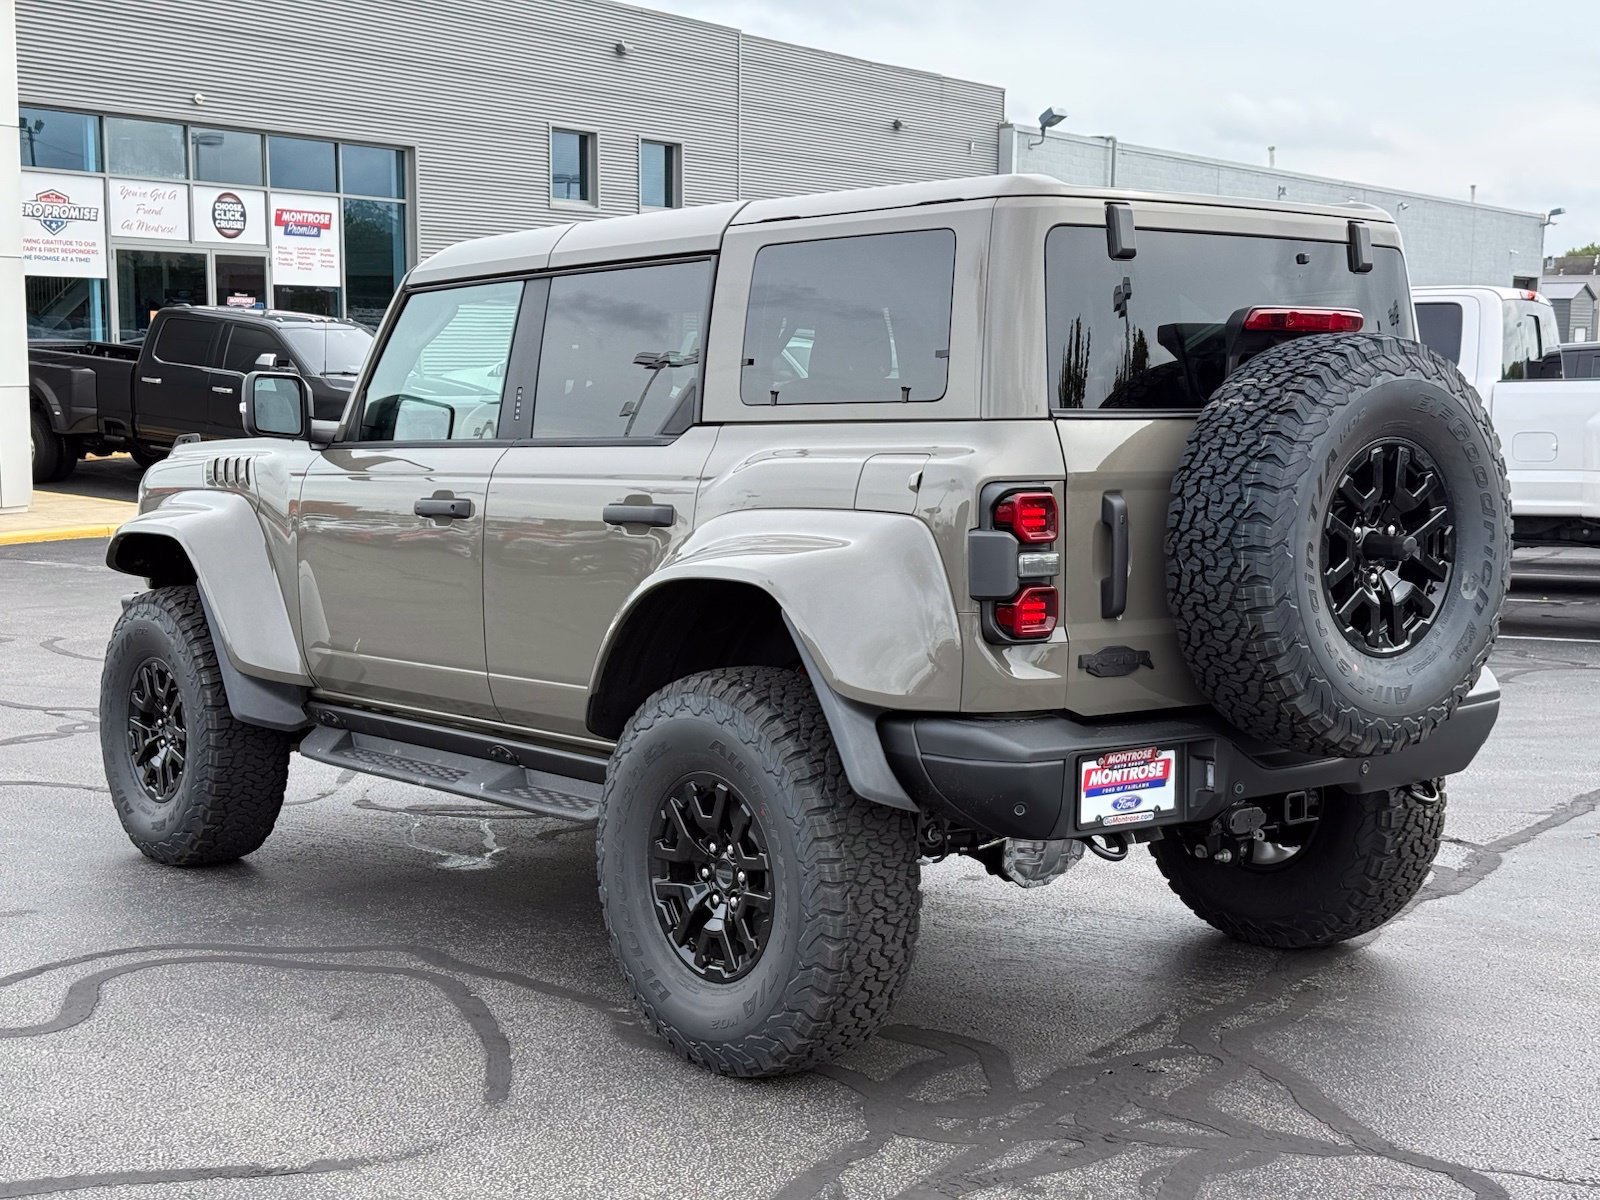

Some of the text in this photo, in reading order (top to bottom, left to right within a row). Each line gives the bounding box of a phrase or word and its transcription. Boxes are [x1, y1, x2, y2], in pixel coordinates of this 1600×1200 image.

[120, 185, 178, 202] You've Got A
[22, 203, 98, 221] ERO PROMISE
[136, 203, 164, 215] Friend
[214, 202, 243, 212] CHOOSE.
[214, 210, 244, 221] CLICK.
[281, 211, 330, 225] MONTROSE
[121, 219, 178, 234] At Montrose!
[215, 220, 245, 229] CRUISE!
[287, 222, 319, 235] Promise
[1107, 749, 1153, 765] MONTROSE
[1088, 761, 1165, 786] MONTROSE
[1116, 796, 1137, 810] Ford
[1104, 812, 1154, 825] GoMontrose.com
